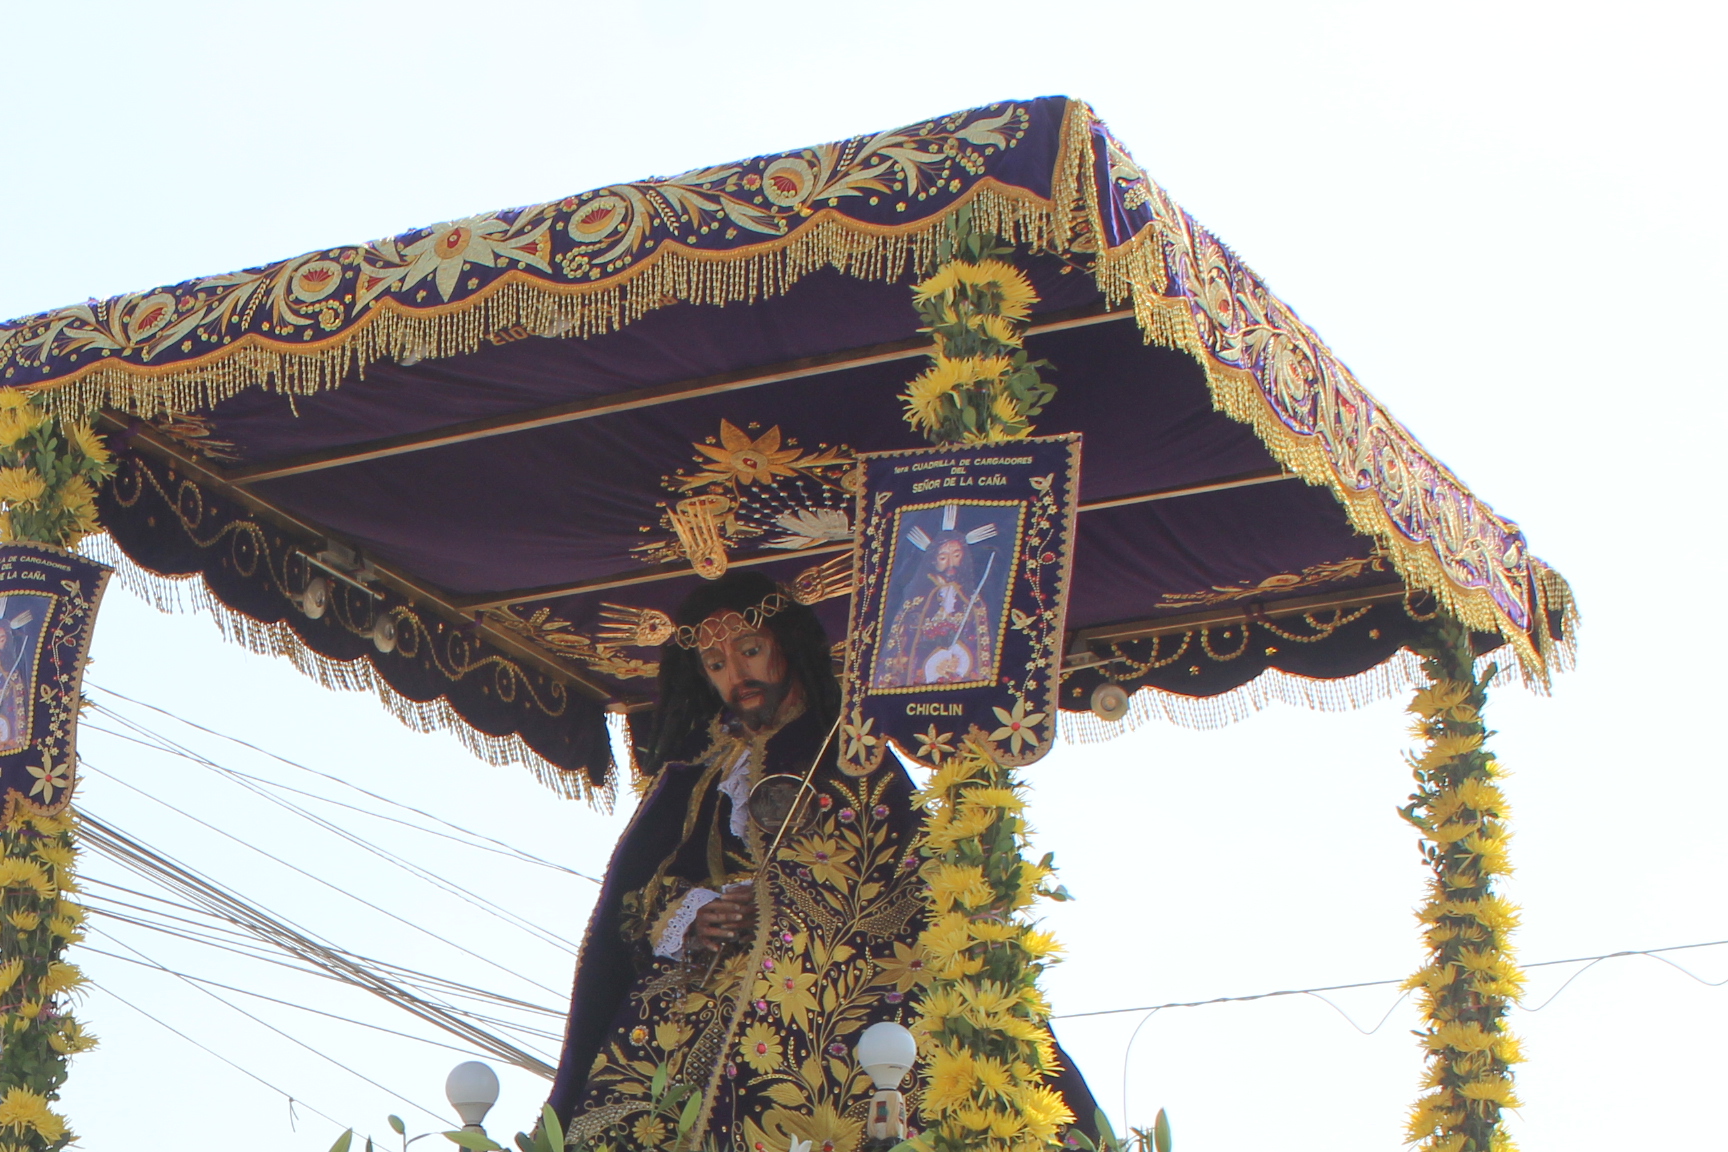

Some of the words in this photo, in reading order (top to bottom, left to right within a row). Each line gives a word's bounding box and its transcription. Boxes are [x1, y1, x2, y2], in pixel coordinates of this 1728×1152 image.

[912, 458, 956, 472] CUADRILLA
[959, 458, 971, 467] DE
[974, 456, 1033, 466] CARGADORES
[950, 466, 967, 475] DEL
[912, 478, 941, 493] SEÑOR
[943, 477, 957, 488] DE
[959, 477, 974, 487] LA
[978, 473, 1008, 486] CAÑA
[1, 563, 13, 571] DEL
[8, 555, 18, 563] DE
[20, 556, 71, 571] CARGADORES
[7, 571, 18, 581] LA
[21, 570, 46, 582] CAÑA
[906, 703, 963, 716] CHICLIN
